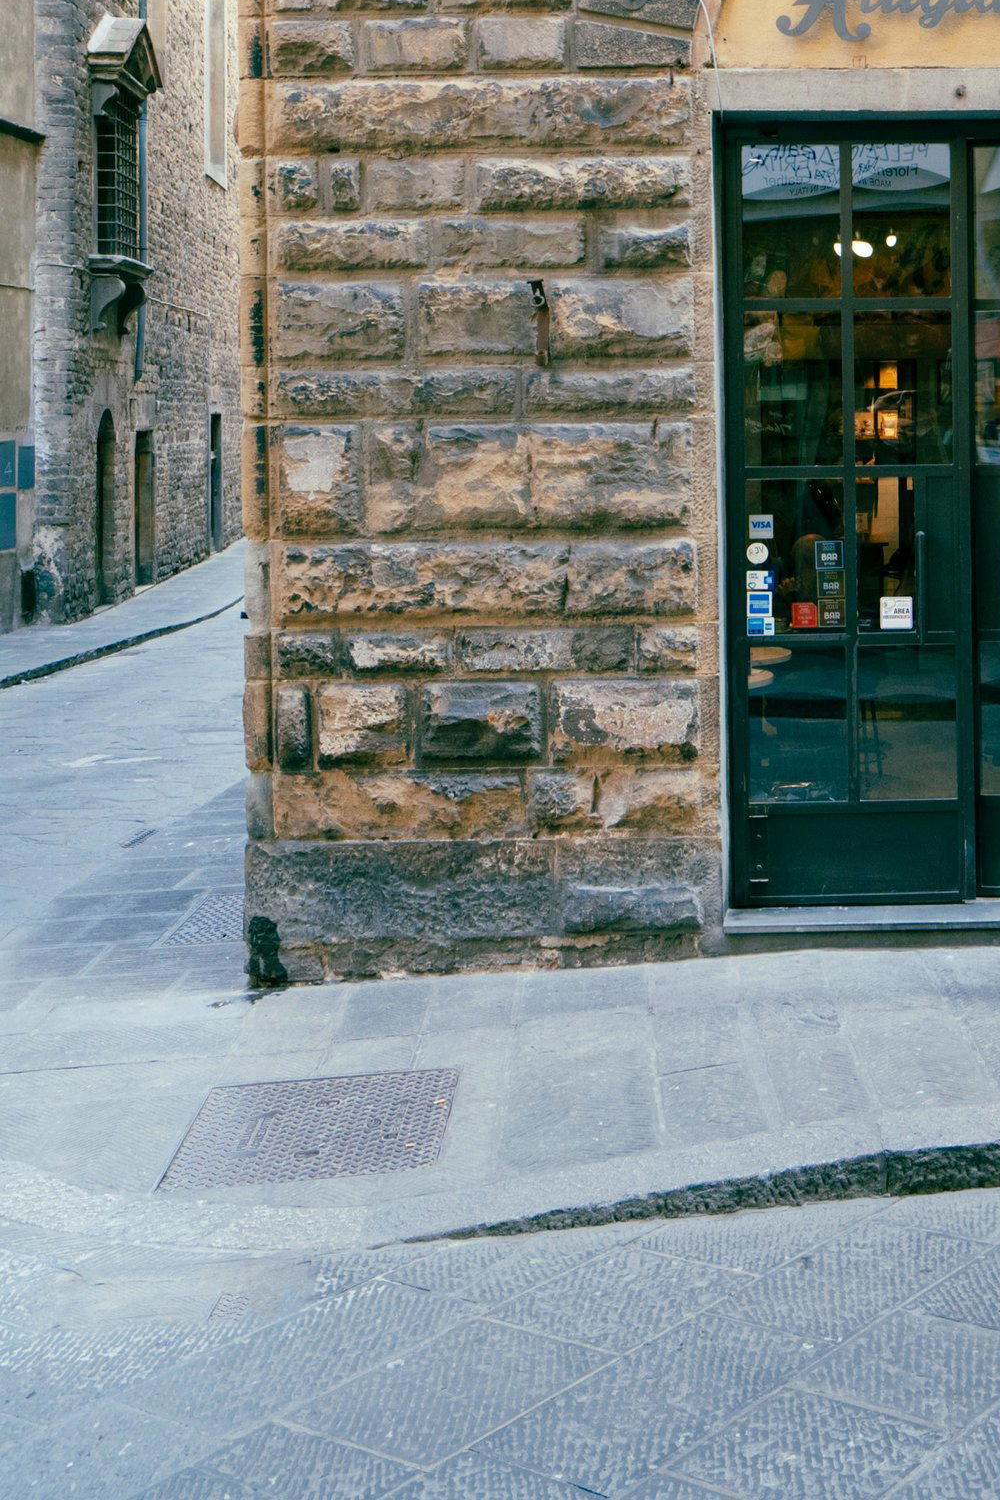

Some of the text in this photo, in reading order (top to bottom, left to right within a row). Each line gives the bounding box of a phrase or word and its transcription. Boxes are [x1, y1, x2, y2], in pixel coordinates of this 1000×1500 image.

[751, 521, 772, 529] VISA
[821, 553, 838, 561] BAR
[823, 582, 840, 590] BAR
[824, 612, 841, 620] BAR
